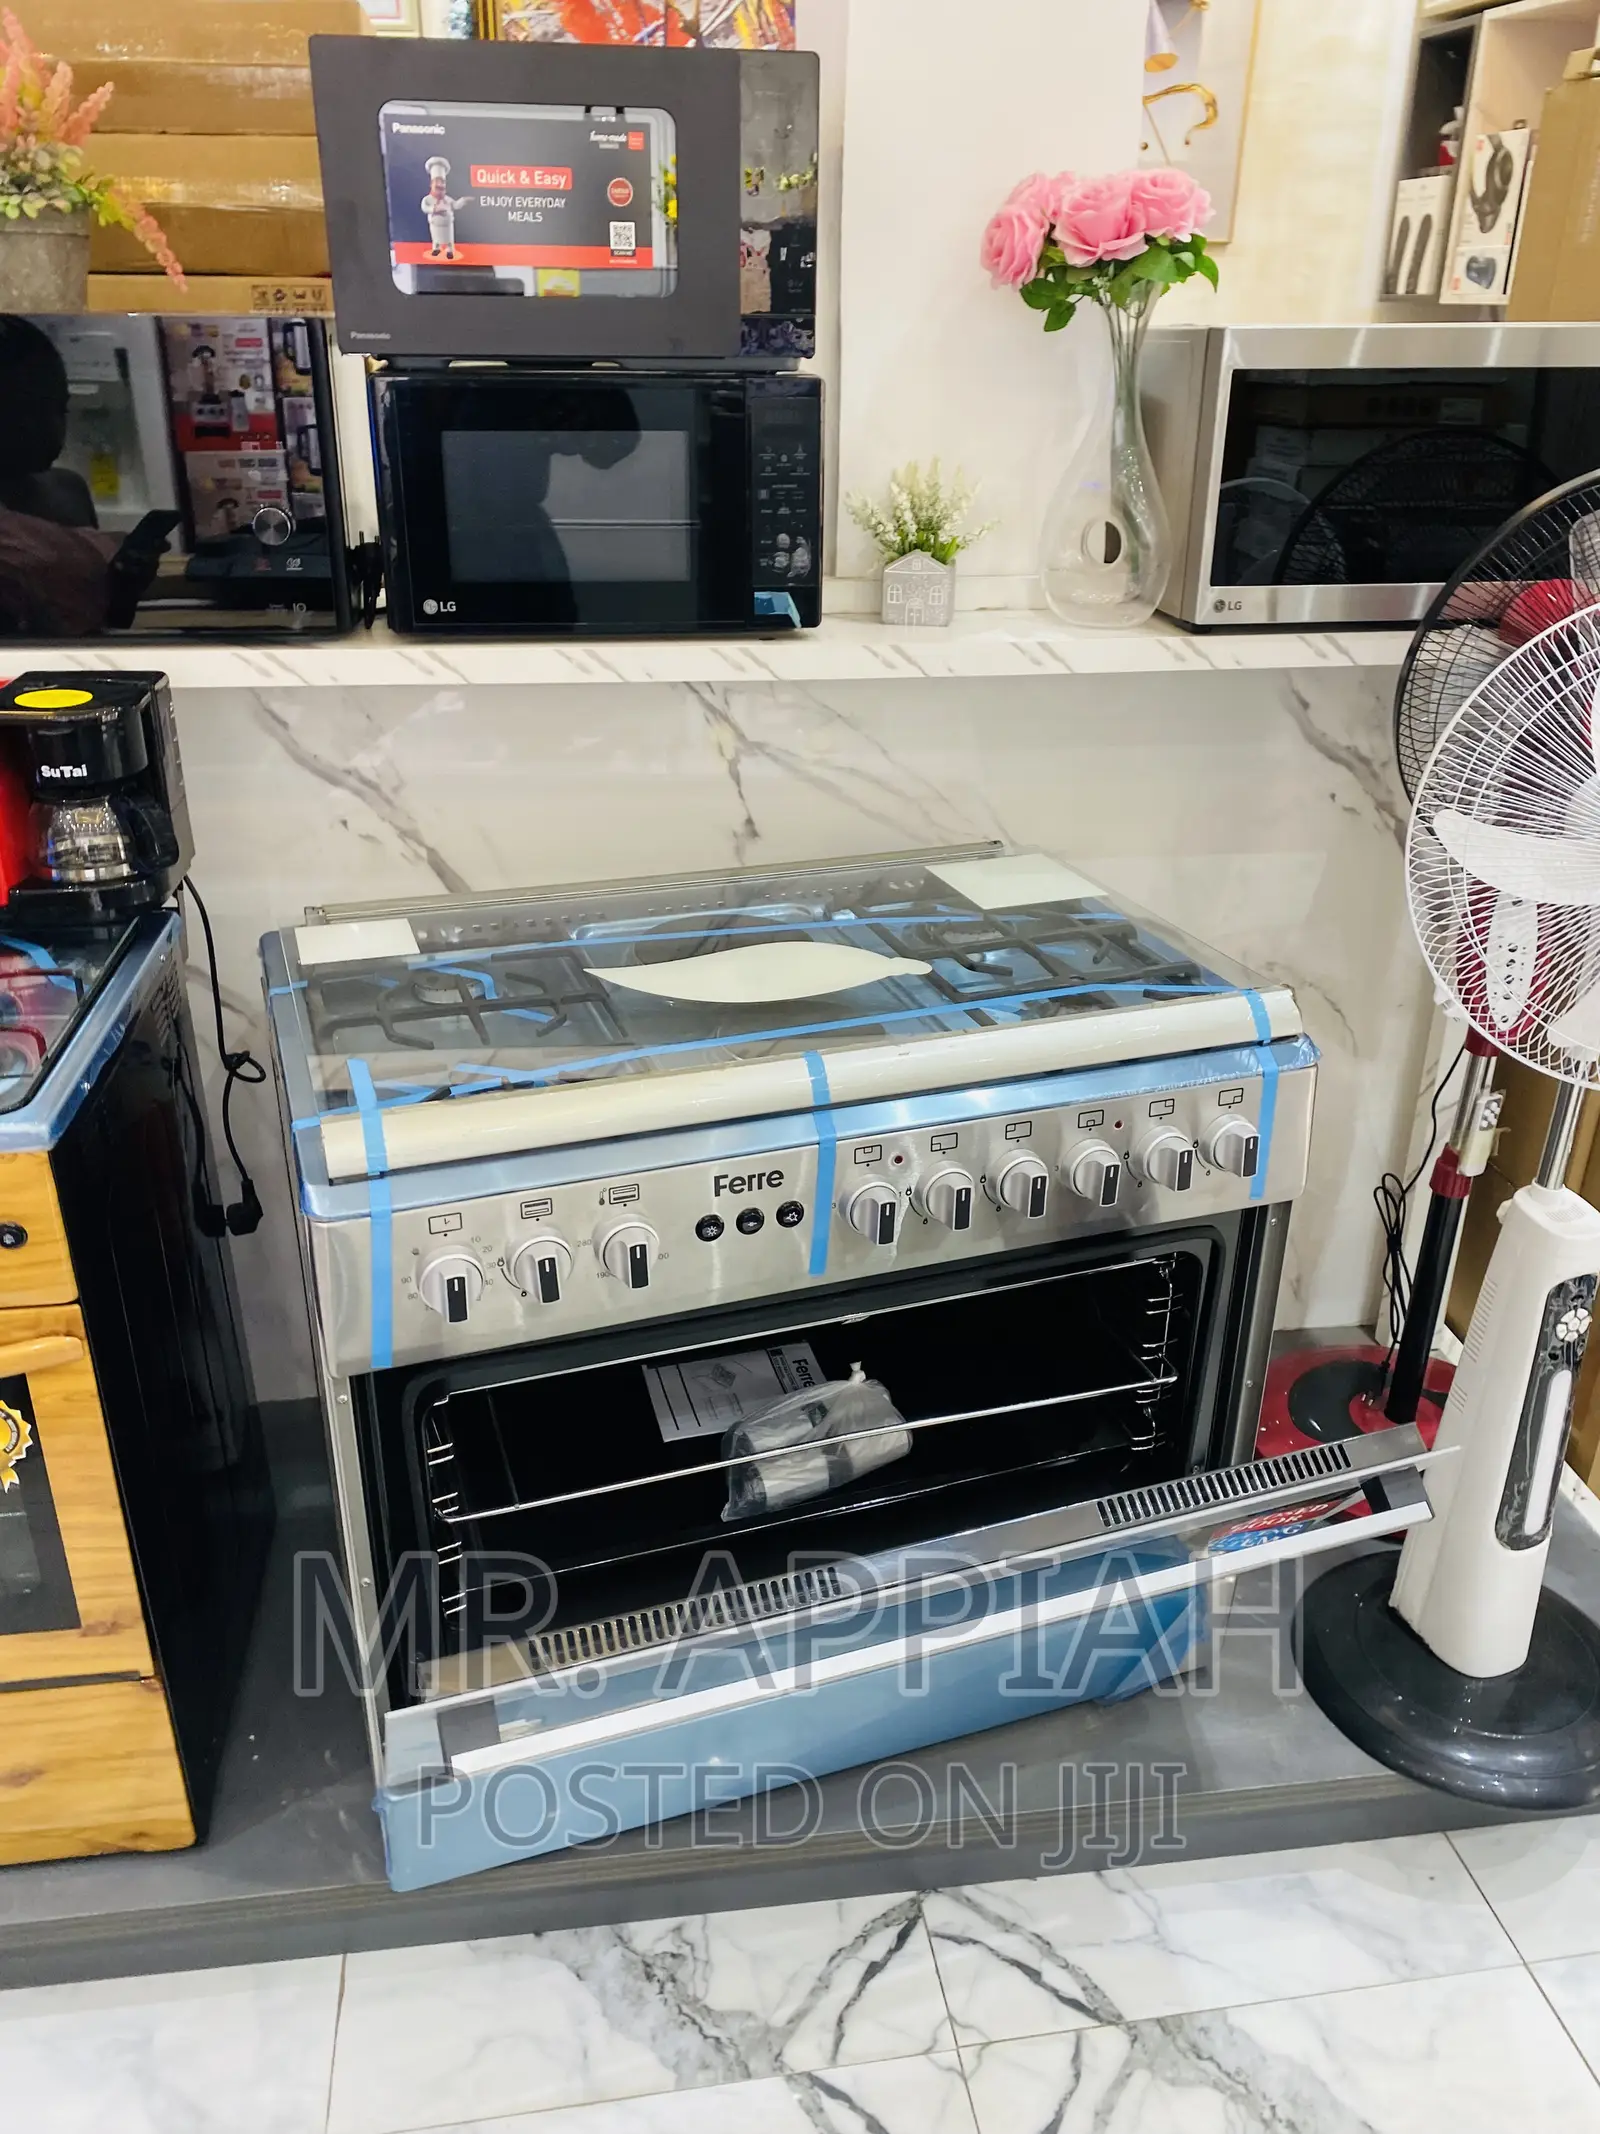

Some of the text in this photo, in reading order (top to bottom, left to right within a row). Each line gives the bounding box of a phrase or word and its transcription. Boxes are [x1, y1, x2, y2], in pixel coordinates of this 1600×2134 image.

[392, 122, 446, 135] Panasonic
[476, 168, 567, 188] Quick & Easy
[480, 195, 566, 208] ENJOY EVERYDAY
[508, 211, 543, 222] MEALS
[440, 601, 457, 612] LG
[1228, 600, 1243, 611] LG
[41, 764, 88, 778] SuTai
[714, 1170, 784, 1197] Ferre
[482, 1245, 493, 1253] 20
[792, 1358, 816, 1388] Ferre
